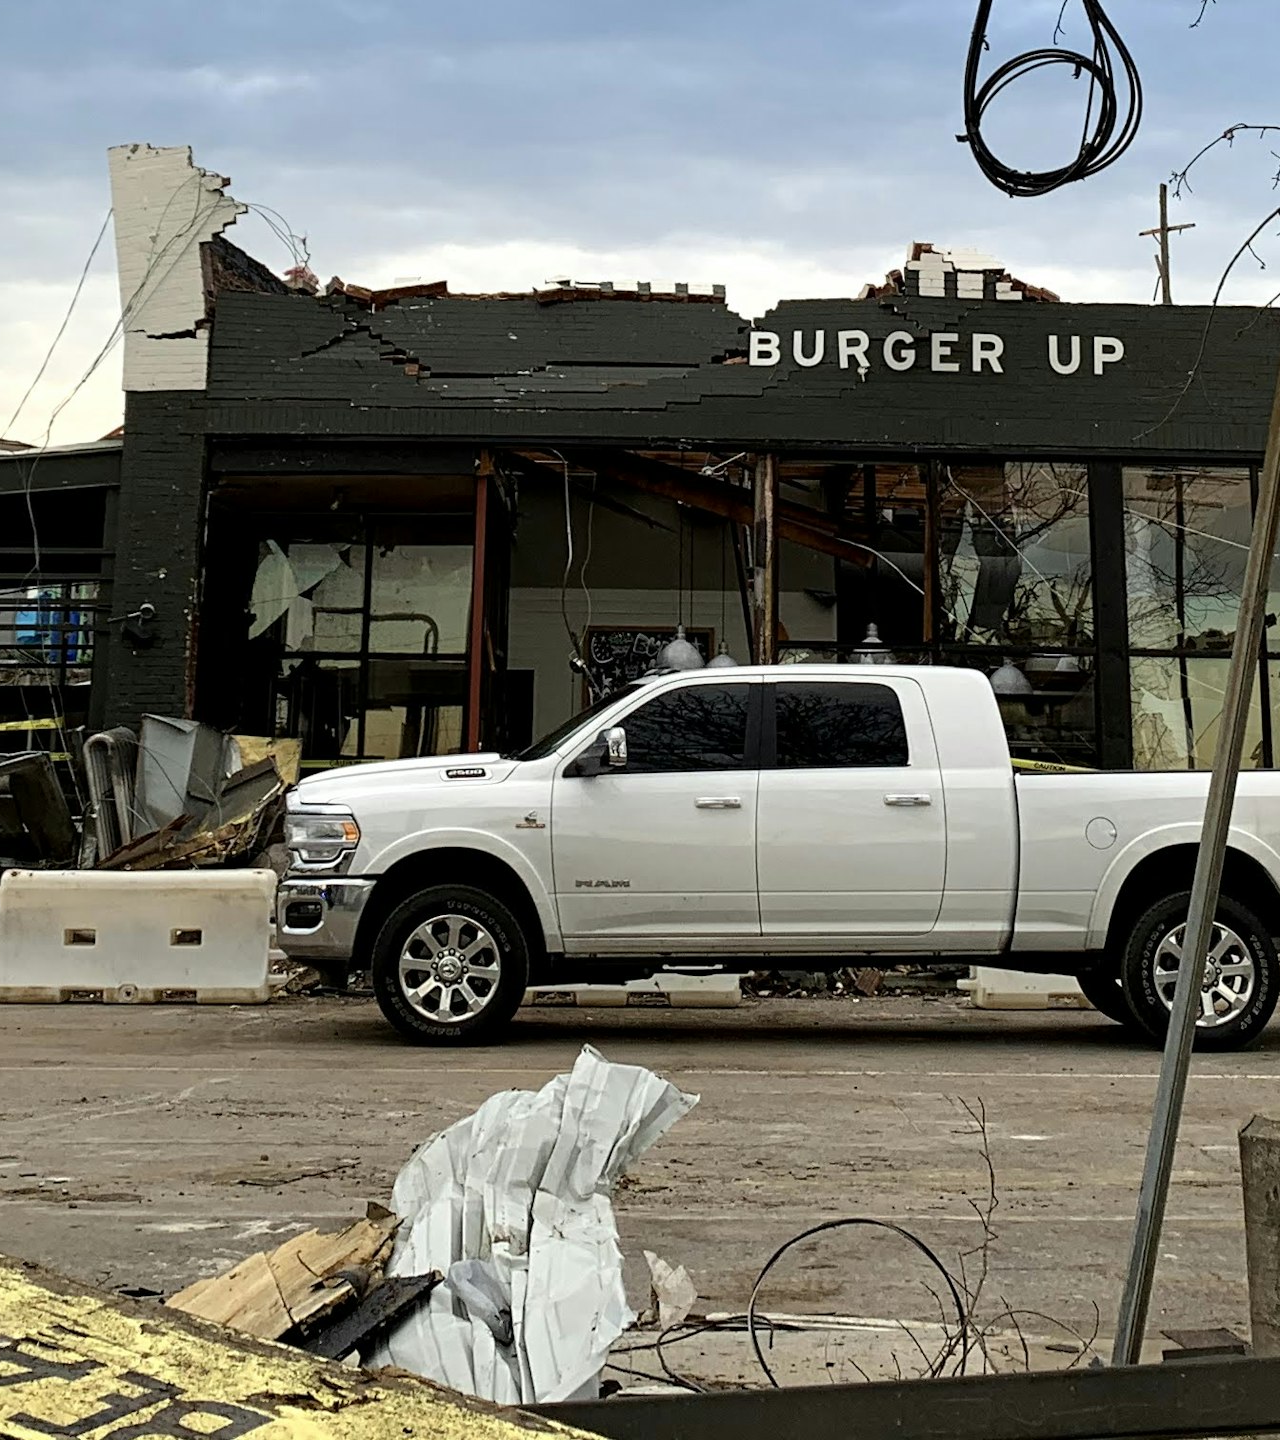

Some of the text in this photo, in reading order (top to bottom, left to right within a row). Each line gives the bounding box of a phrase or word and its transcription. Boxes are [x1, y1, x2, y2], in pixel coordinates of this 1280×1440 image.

[749, 329, 1125, 376] BURGER UP
[1033, 762, 1066, 771] CAUTION
[575, 879, 631, 888] RAM
